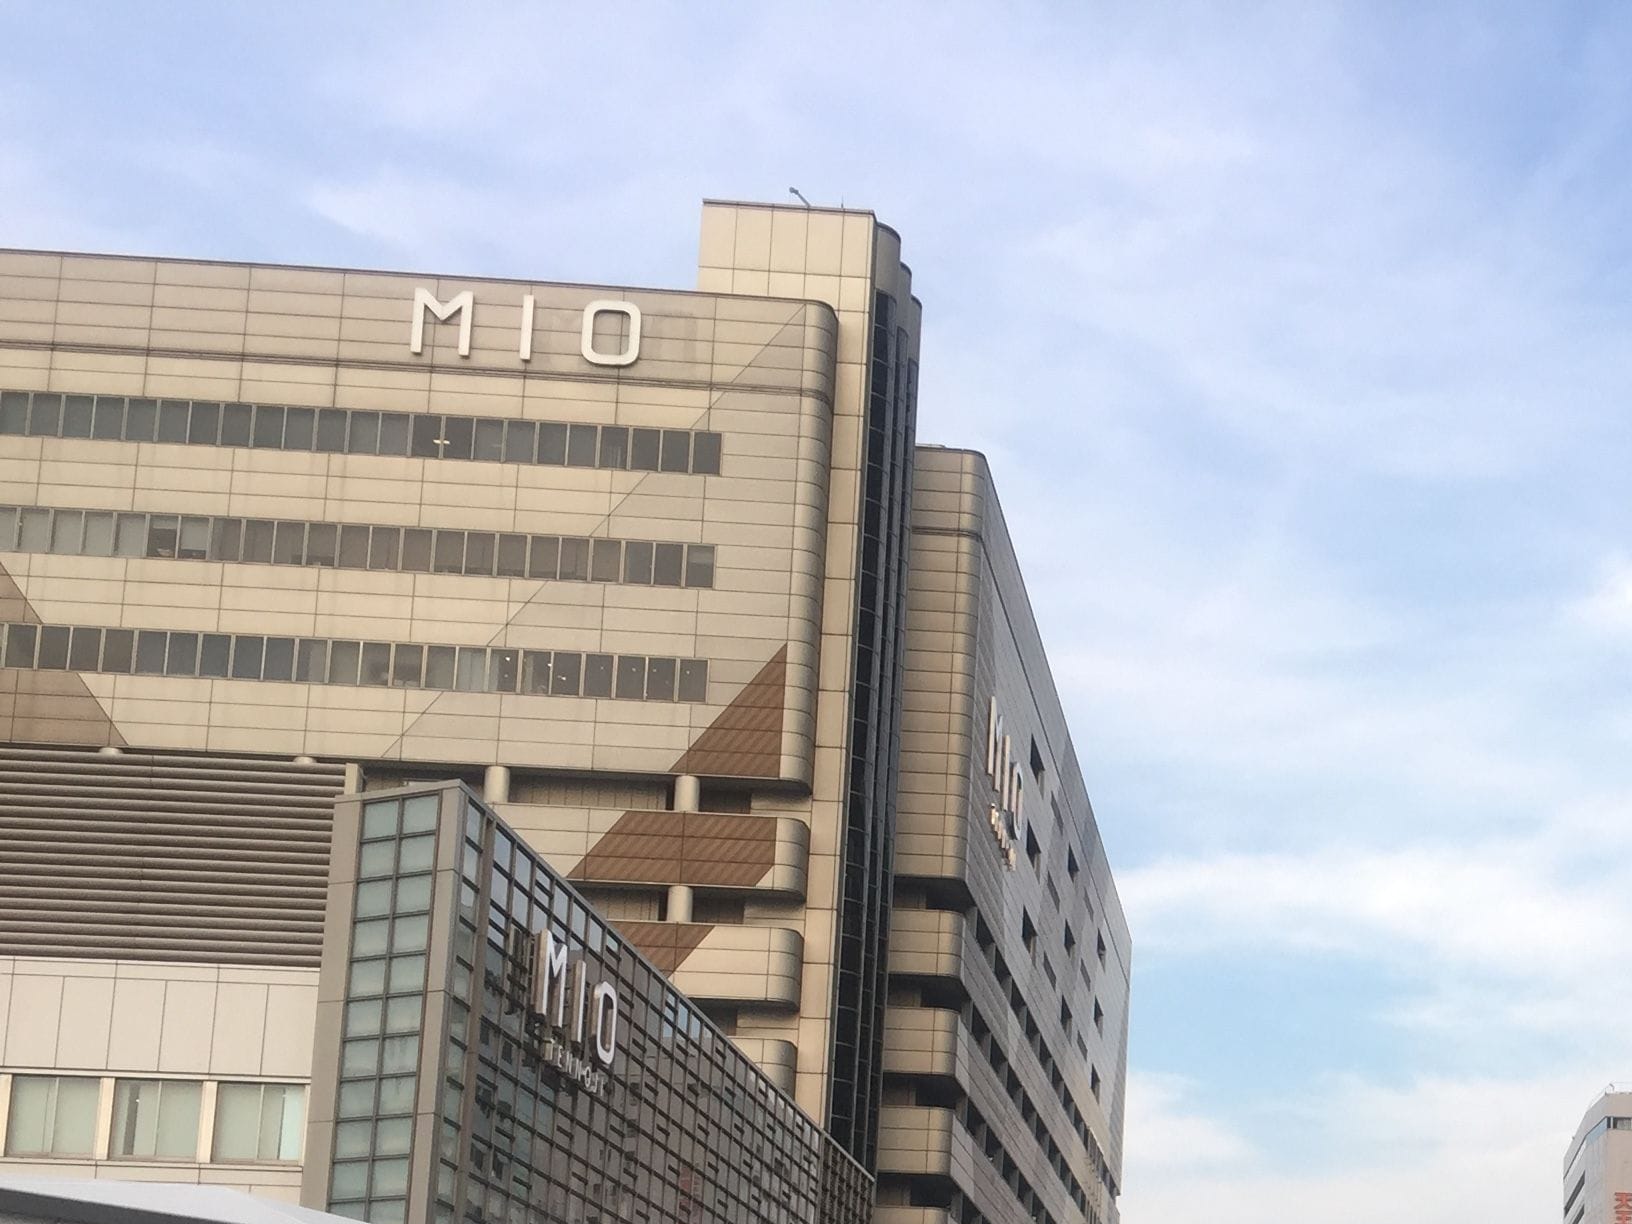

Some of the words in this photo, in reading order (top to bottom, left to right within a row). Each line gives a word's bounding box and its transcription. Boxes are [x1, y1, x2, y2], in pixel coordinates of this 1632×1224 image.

[410, 287, 642, 366] MIO
[986, 695, 1024, 841] MIO
[532, 928, 618, 1065] MIO
